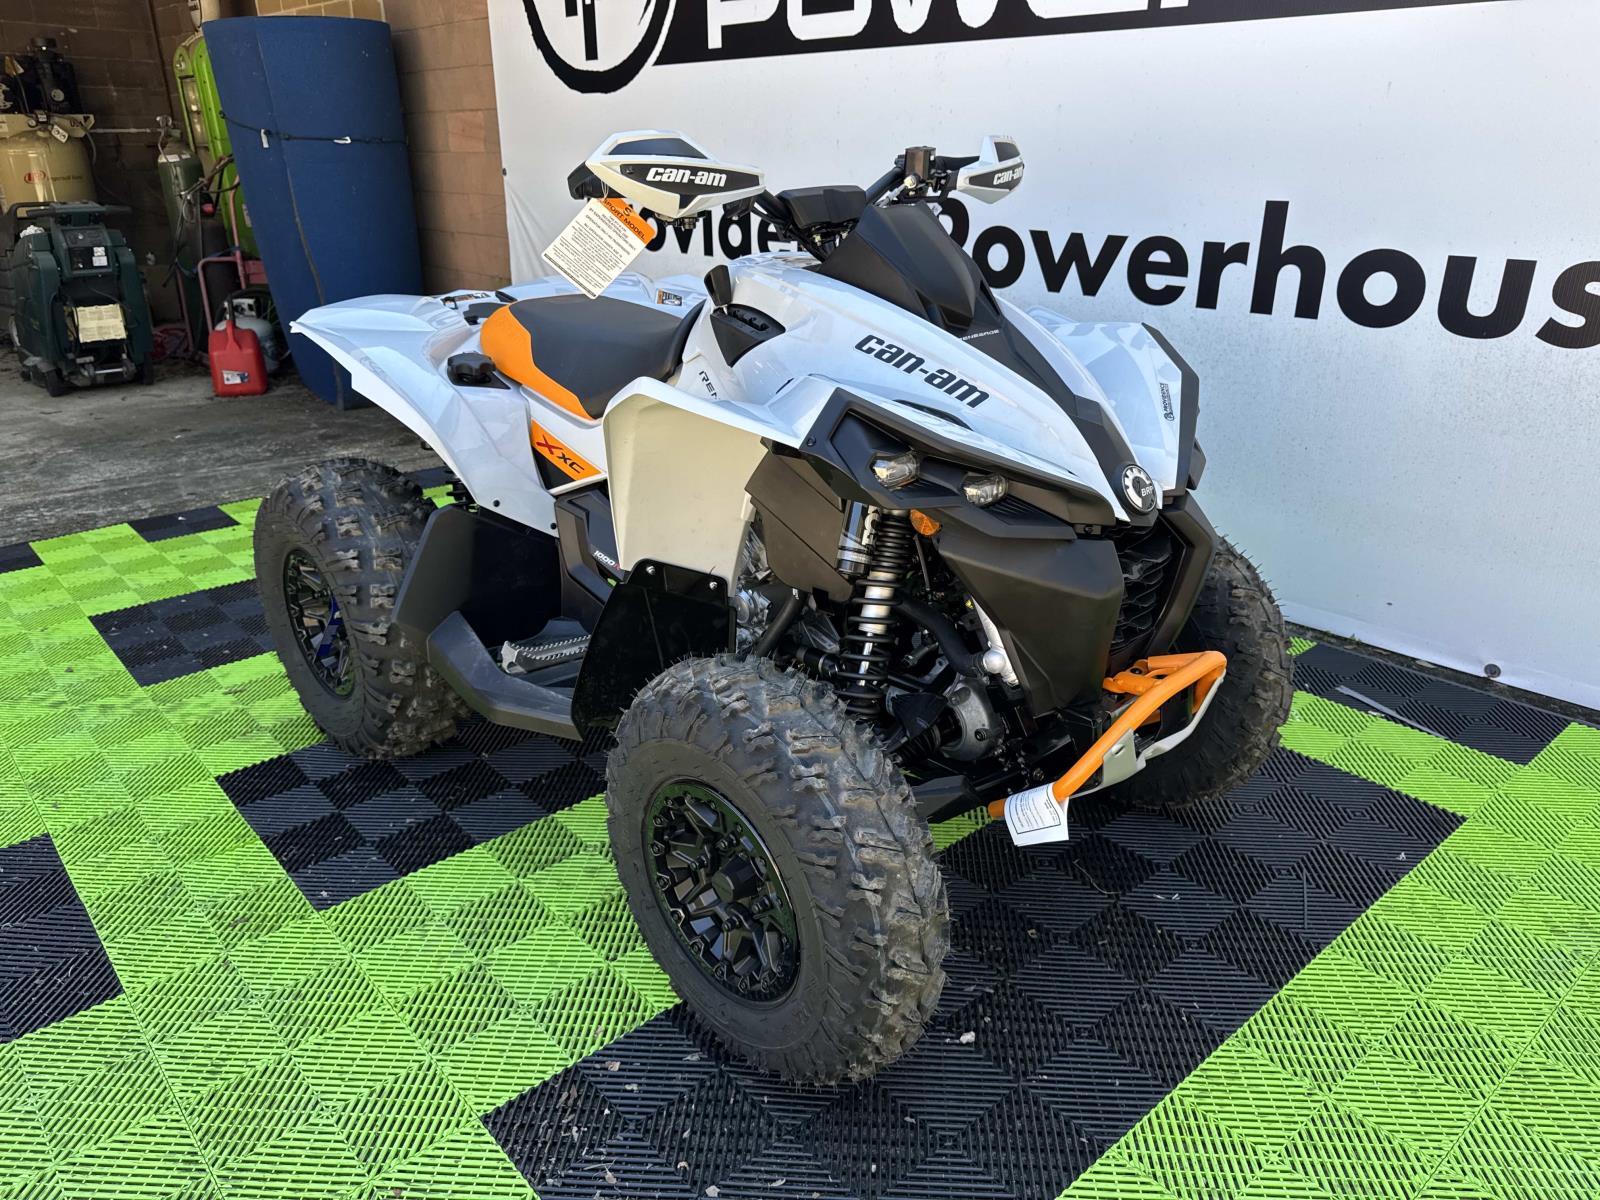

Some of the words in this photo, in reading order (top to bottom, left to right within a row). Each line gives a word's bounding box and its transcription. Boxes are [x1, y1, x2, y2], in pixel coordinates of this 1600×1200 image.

[645, 167, 728, 188] can-am
[623, 218, 647, 241] MODEL
[854, 334, 990, 409] can-am
[1141, 485, 1154, 498] BRP
